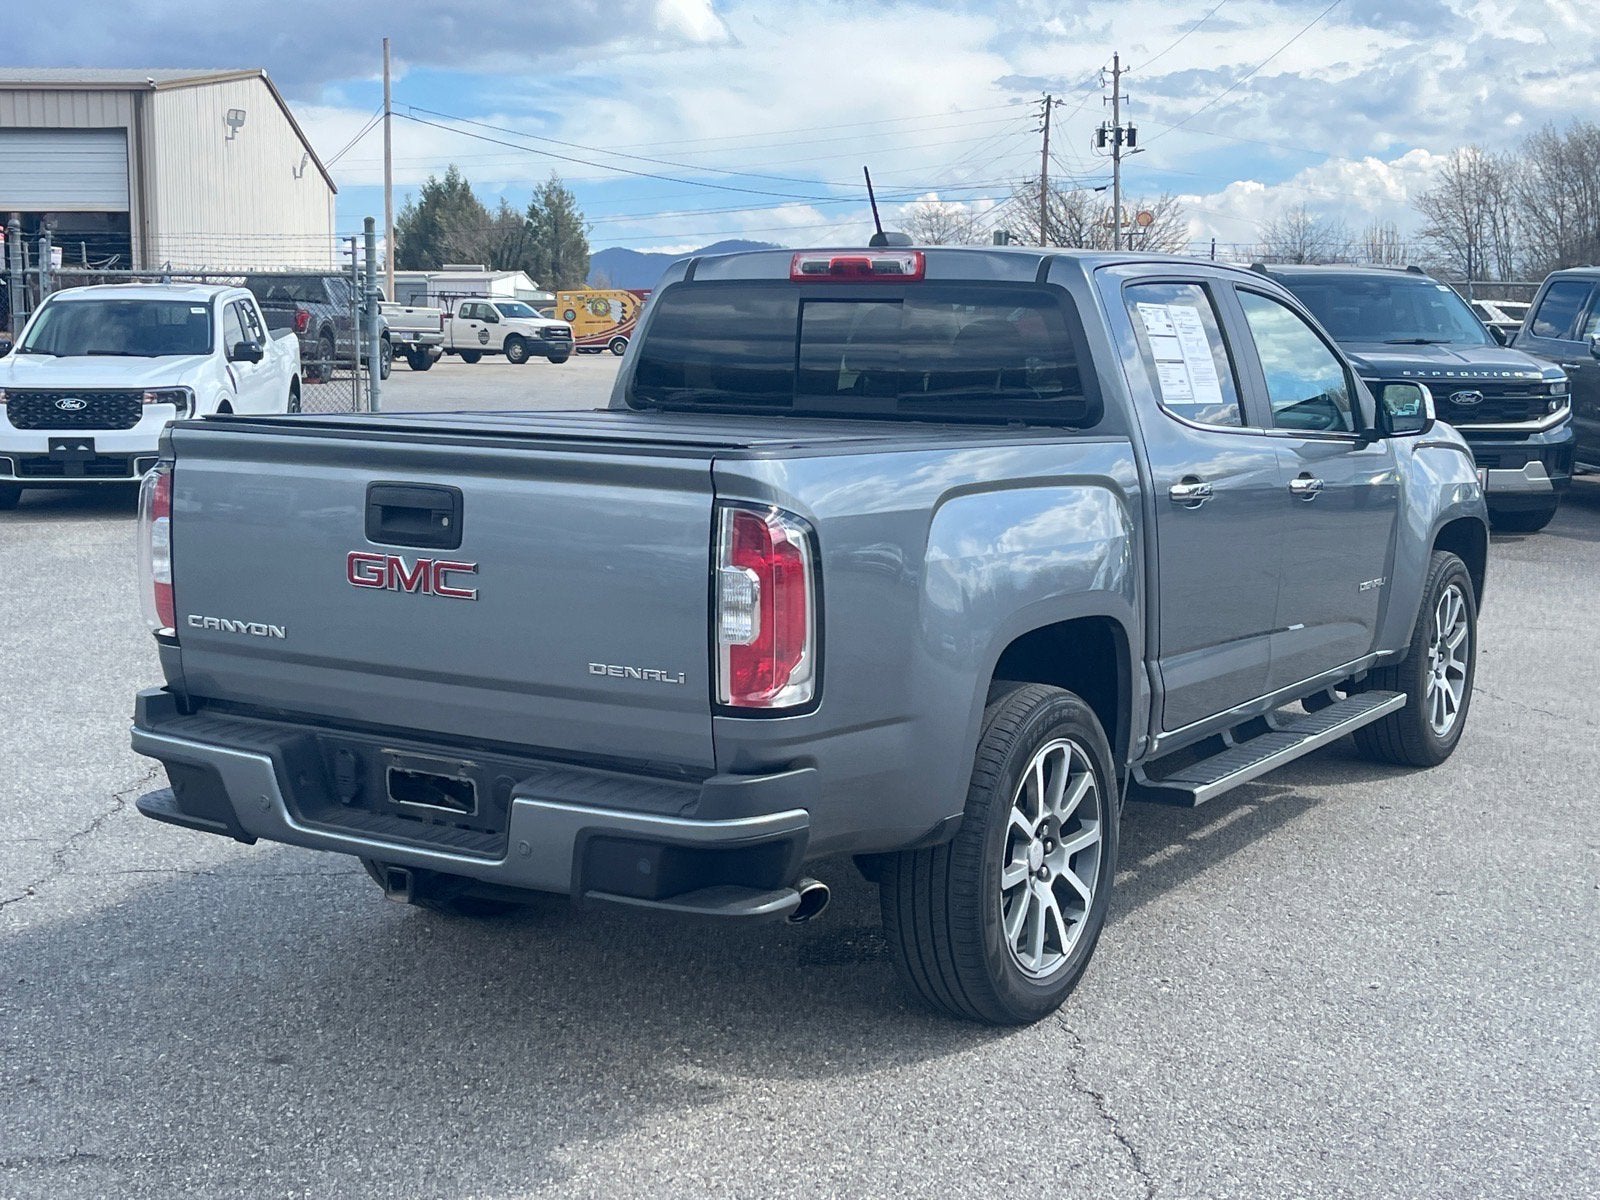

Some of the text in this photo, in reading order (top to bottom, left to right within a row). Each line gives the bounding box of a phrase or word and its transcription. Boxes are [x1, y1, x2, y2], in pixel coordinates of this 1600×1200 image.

[59, 399, 82, 410] Ford
[1454, 392, 1480, 404] Ford
[347, 551, 478, 600] GMC
[187, 614, 285, 639] CANYON
[588, 662, 685, 685] DENALI
